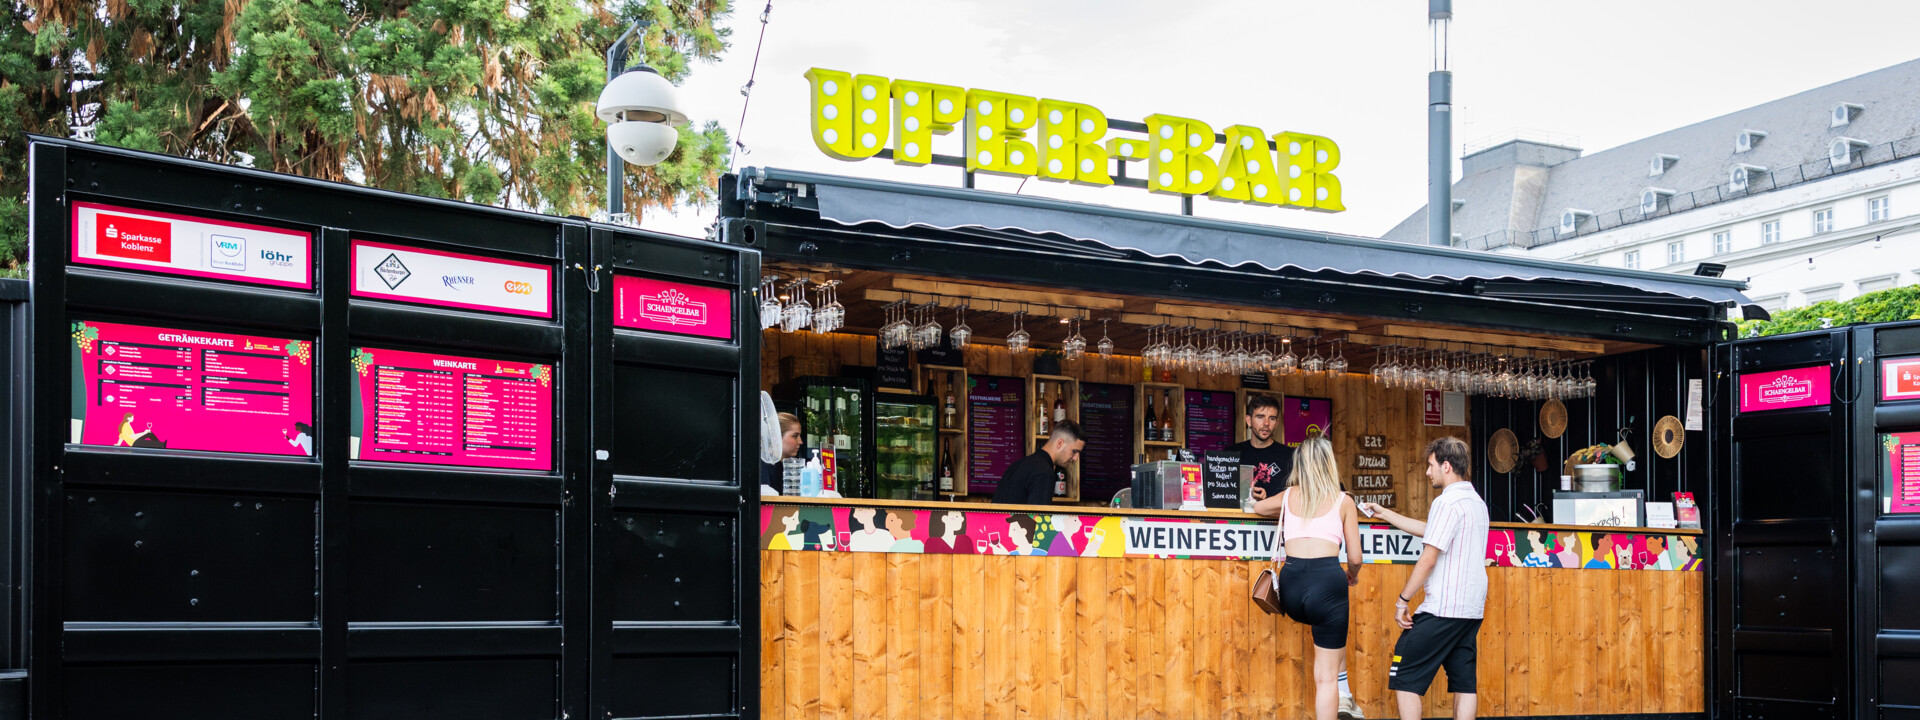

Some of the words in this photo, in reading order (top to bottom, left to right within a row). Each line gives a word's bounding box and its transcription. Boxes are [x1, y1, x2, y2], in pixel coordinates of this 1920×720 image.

[803, 67, 1346, 213] UFER-BAR
[121, 232, 162, 244] Sparkasse
[121, 242, 154, 252] Koblenz
[215, 240, 238, 250] VRM
[261, 249, 293, 262] löhr
[269, 260, 294, 268] gruppe
[505, 282, 531, 295] evm
[646, 303, 700, 317] SCHAENGELBAR
[158, 333, 234, 347] GETRÄNKEKARTE
[433, 359, 477, 370] WEINKARTE
[1764, 386, 1806, 396] SCHAENGELBAR
[1364, 436, 1382, 447] Eat
[1207, 455, 1240, 465] handgemachter
[1358, 455, 1387, 468] Drink
[1209, 463, 1226, 472] Kuchen
[1215, 472, 1232, 480] Kaffee!
[1357, 476, 1388, 487] RELAX
[1207, 481, 1216, 489] pro
[1216, 480, 1229, 488] Stück
[1366, 494, 1393, 505] HAPPY
